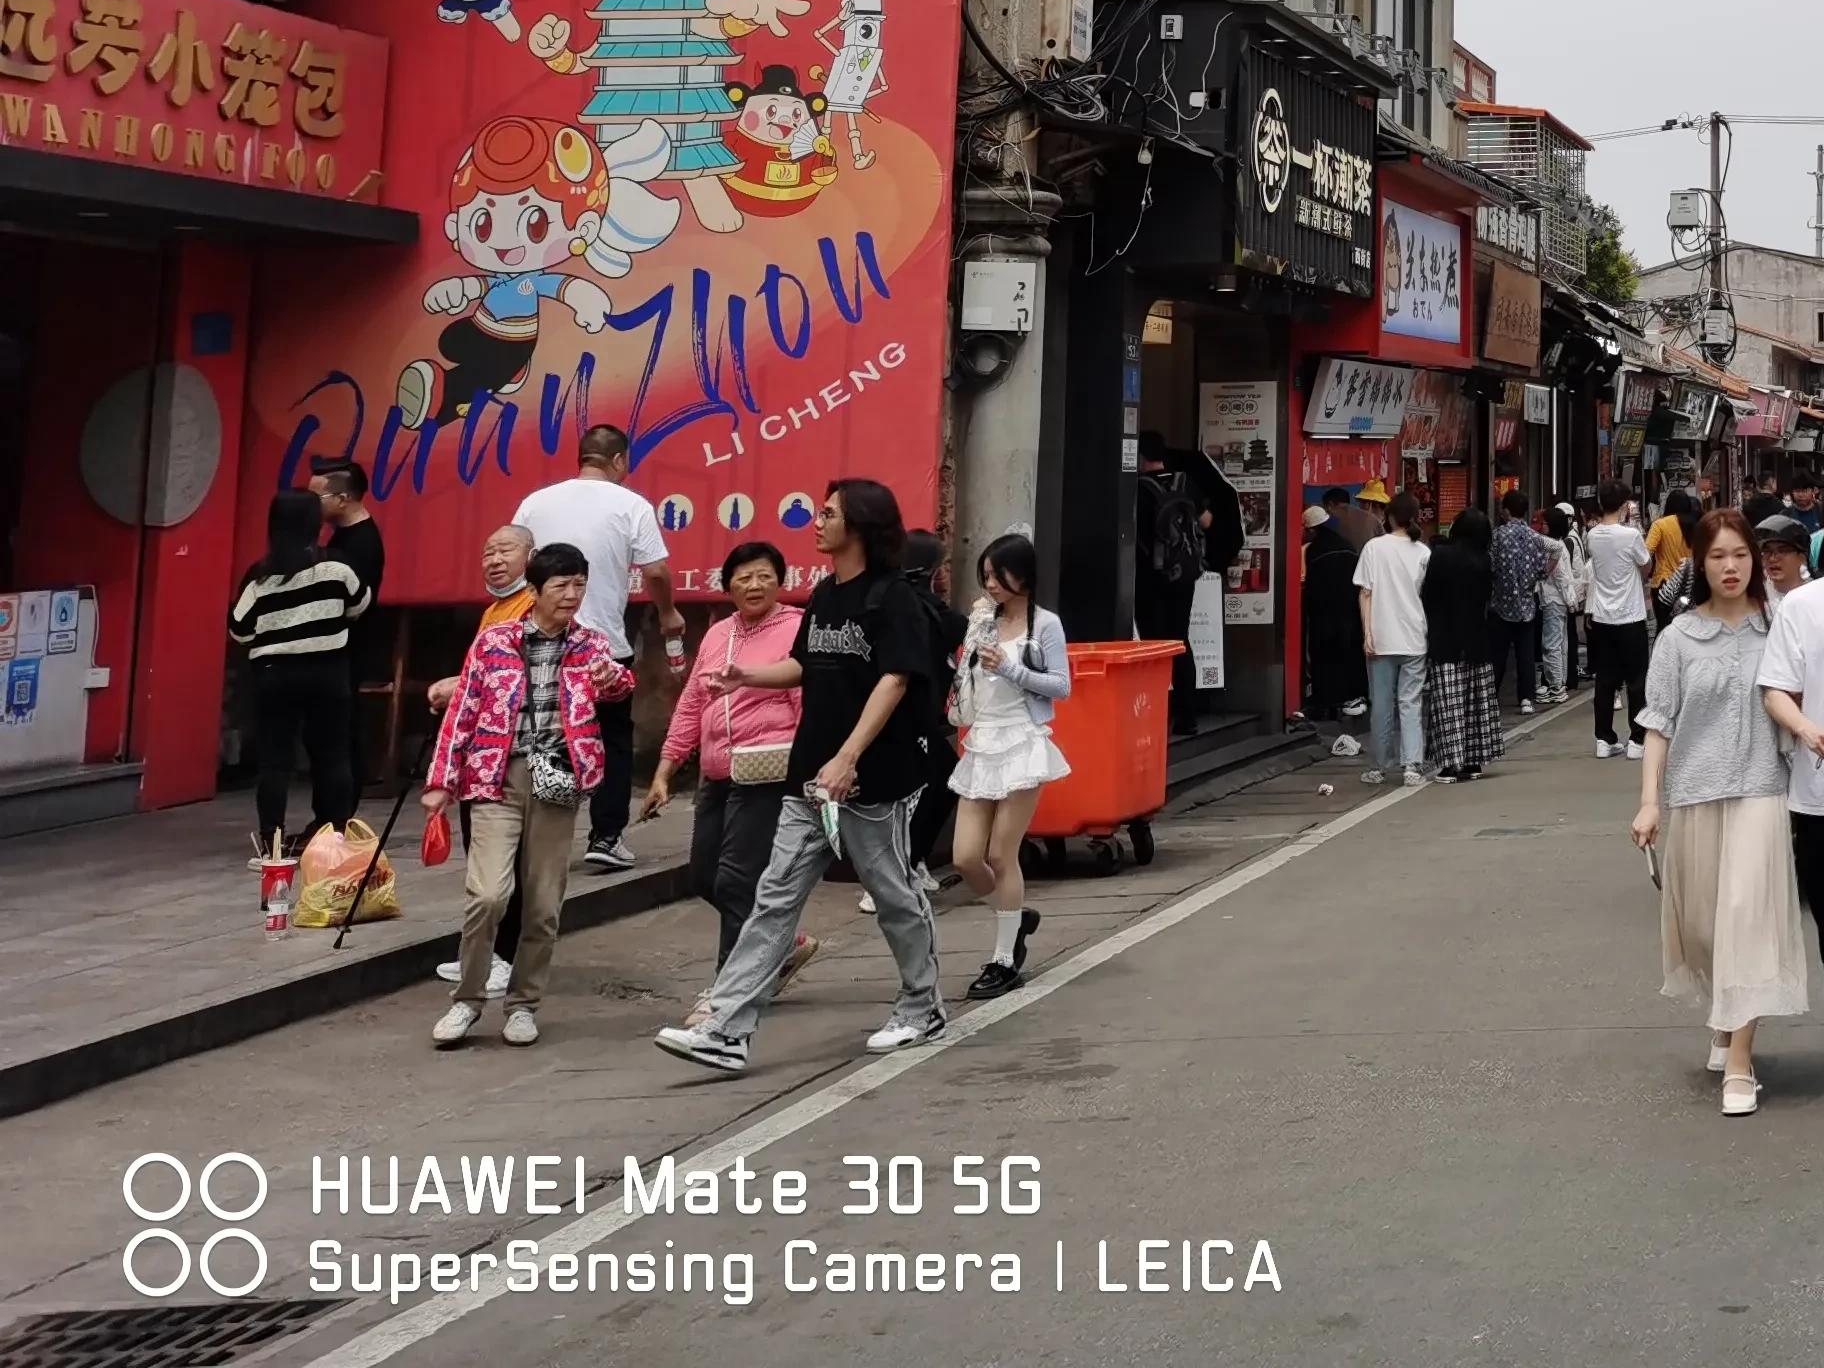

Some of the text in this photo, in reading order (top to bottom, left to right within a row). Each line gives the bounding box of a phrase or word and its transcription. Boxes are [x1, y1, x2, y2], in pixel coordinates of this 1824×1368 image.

[1291, 138, 1374, 218] 一杯潮茶
[1412, 297, 1434, 323] おでん
[702, 342, 908, 468] LI CHENG
